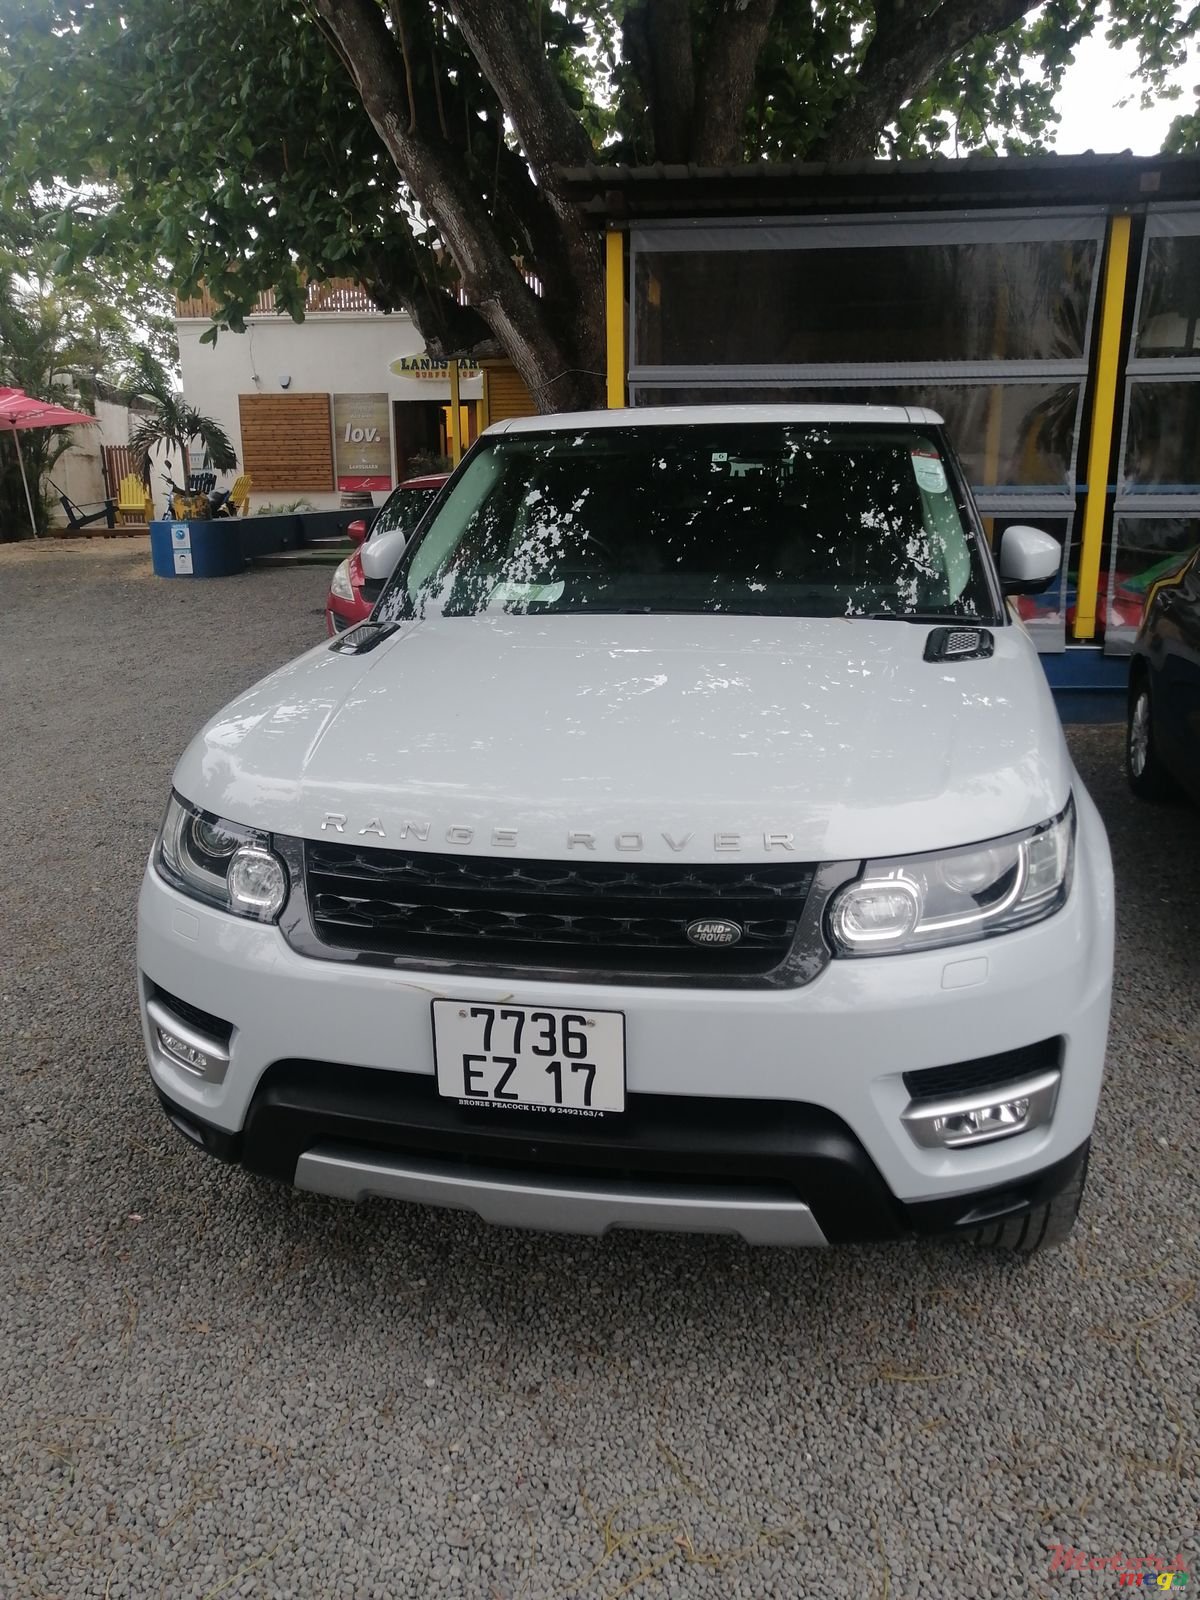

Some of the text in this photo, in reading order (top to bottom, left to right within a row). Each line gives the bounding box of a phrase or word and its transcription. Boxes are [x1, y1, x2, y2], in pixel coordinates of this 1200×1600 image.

[401, 358, 478, 370] LANDSAR
[320, 812, 796, 851] RANGE ROVER
[697, 924, 725, 933] LAND
[699, 933, 733, 942] ROVER
[470, 1007, 588, 1059] 7736
[463, 1054, 597, 1107] EZ 17
[458, 1099, 490, 1108] BRONZE
[492, 1102, 530, 1111] PEACOCK
